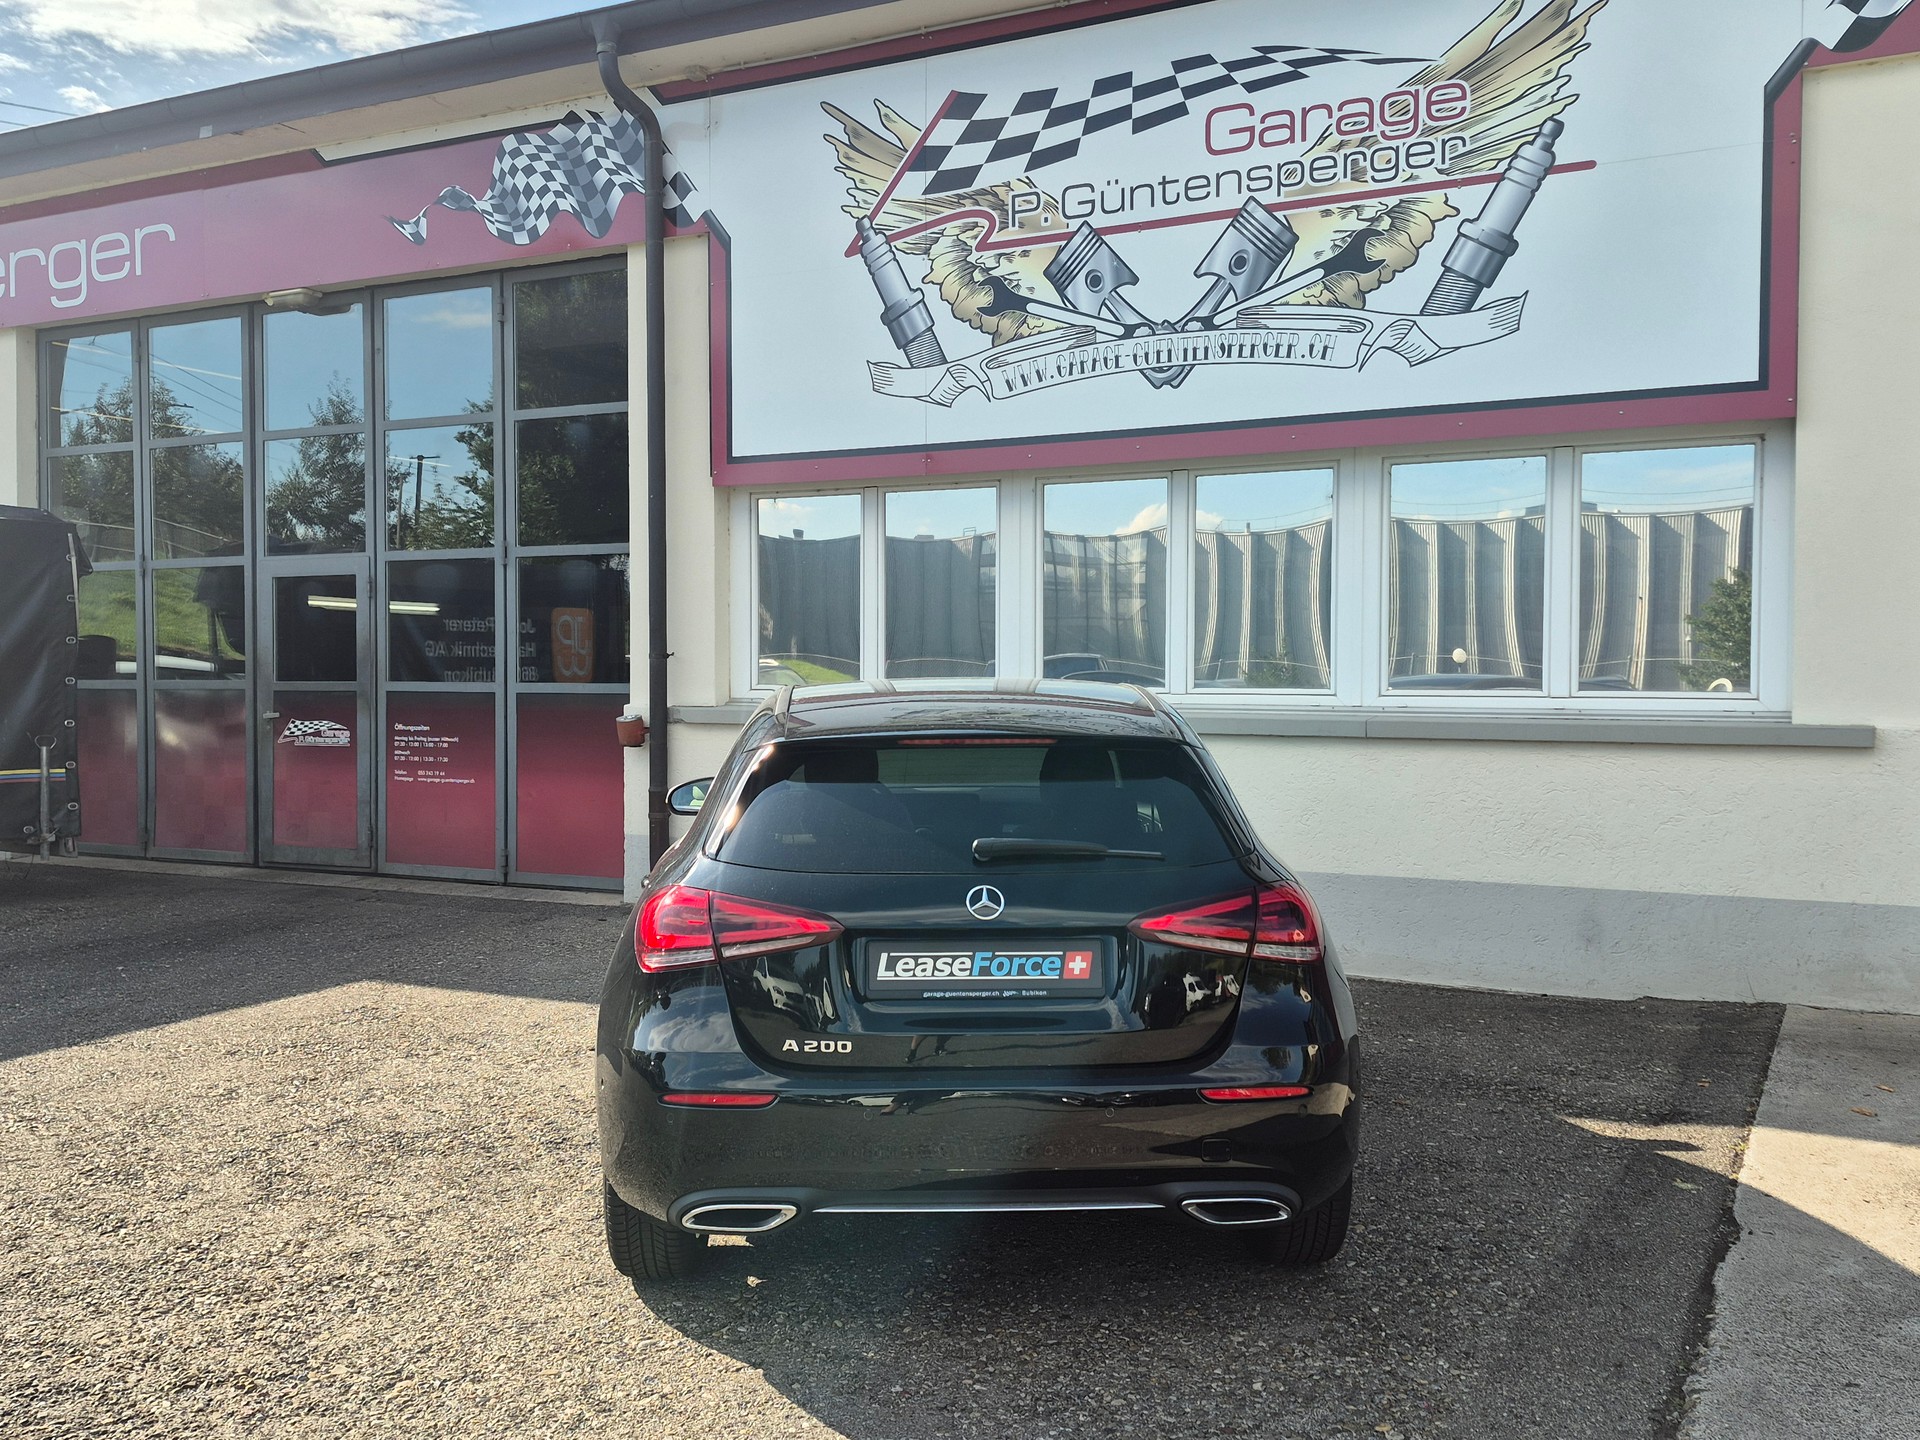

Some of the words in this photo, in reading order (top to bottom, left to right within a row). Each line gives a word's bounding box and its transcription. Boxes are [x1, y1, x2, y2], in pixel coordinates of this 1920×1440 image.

[1204, 80, 1468, 157] Garage
[1061, 134, 1467, 220] Güntensperger
[0, 223, 176, 309] rger
[1001, 332, 1338, 393] WWW.GARAGE-GUENTENSPERGER.CH
[877, 951, 1062, 979] LeaseForce
[923, 989, 1000, 998] garage-guentensperger.ch
[782, 1039, 799, 1052] A
[803, 1040, 852, 1054] 200
